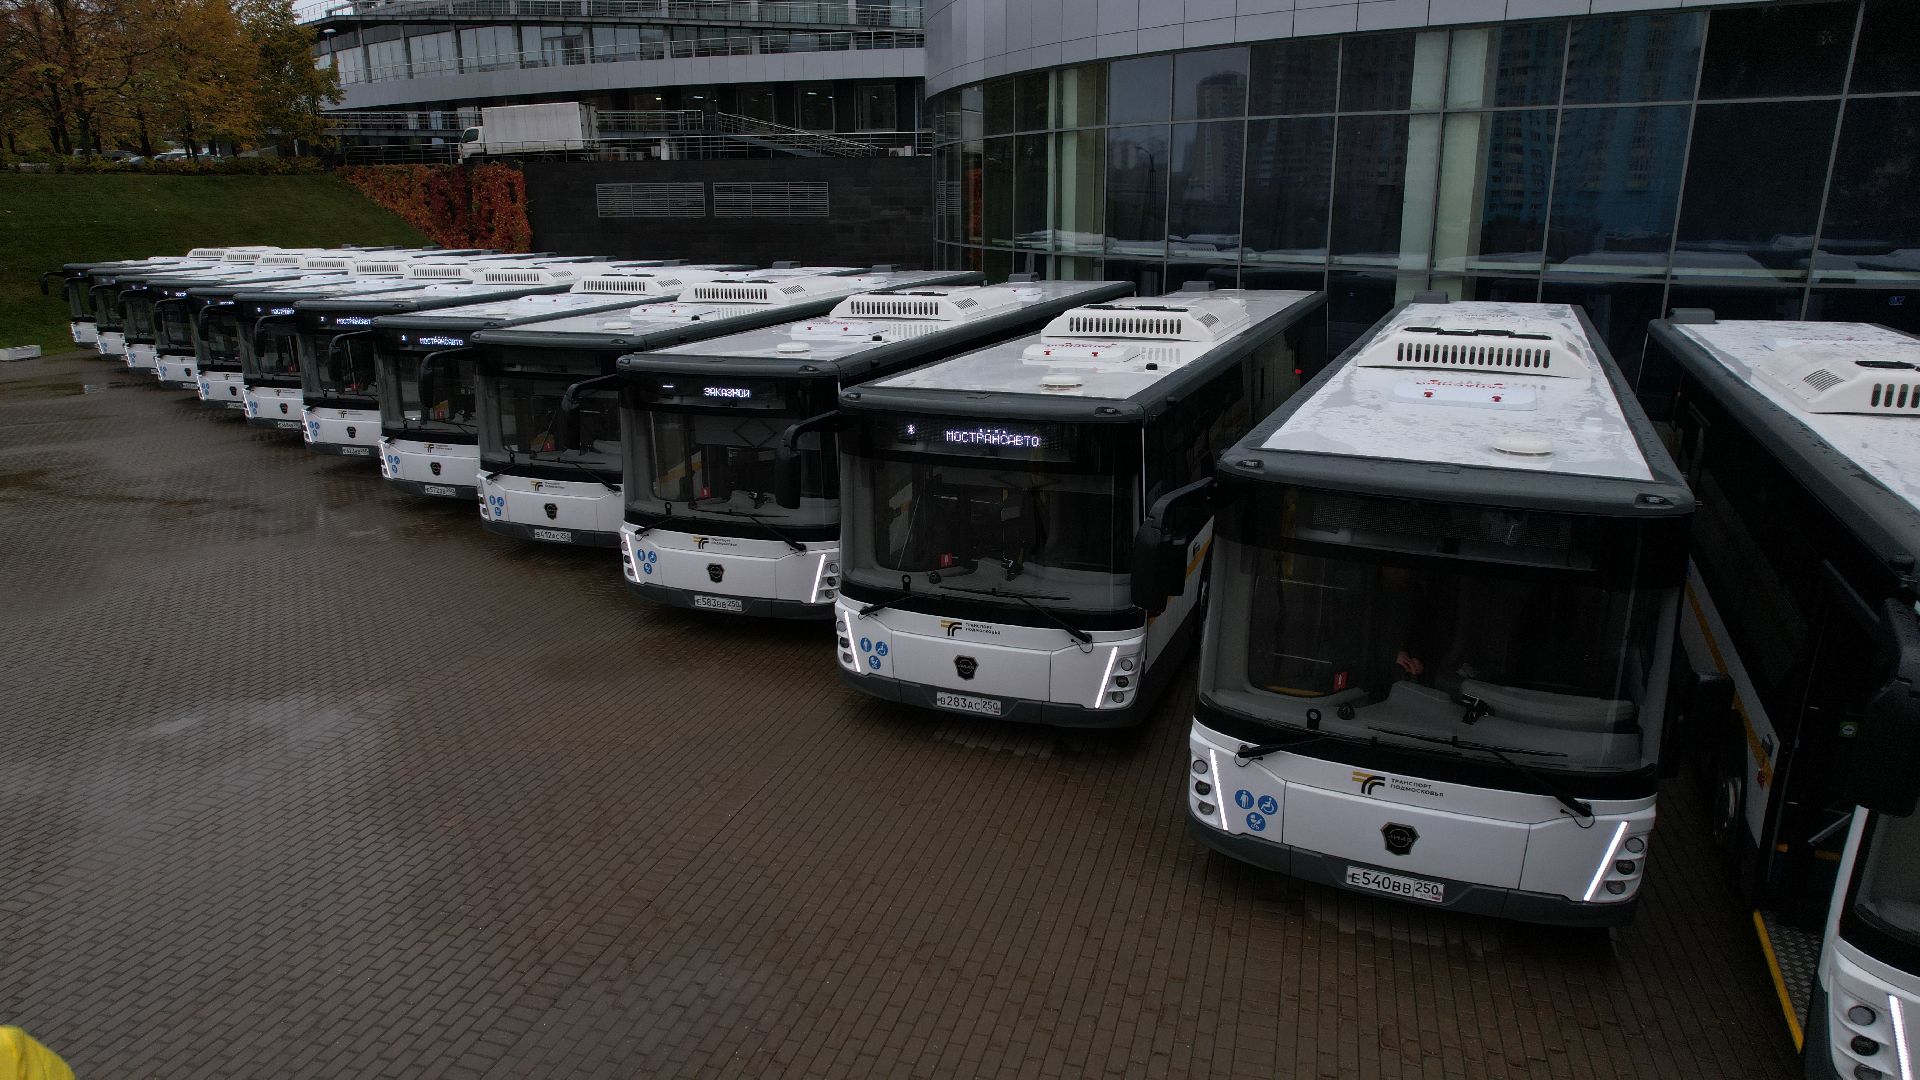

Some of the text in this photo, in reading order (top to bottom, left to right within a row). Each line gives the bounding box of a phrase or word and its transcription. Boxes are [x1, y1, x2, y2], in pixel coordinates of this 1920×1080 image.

[419, 336, 464, 346] МОСТРАНСАВТО
[703, 387, 750, 398] ЗАКАЗНОЙ
[946, 430, 1040, 447] МОСТРАНСАВТО
[939, 695, 999, 711] В283АС 250
[1390, 783, 1444, 797] ПОДМОСКОВЬЯ
[1391, 778, 1432, 790] ТРАНСПОРТ
[1351, 871, 1439, 896] Е540ВВ 250
